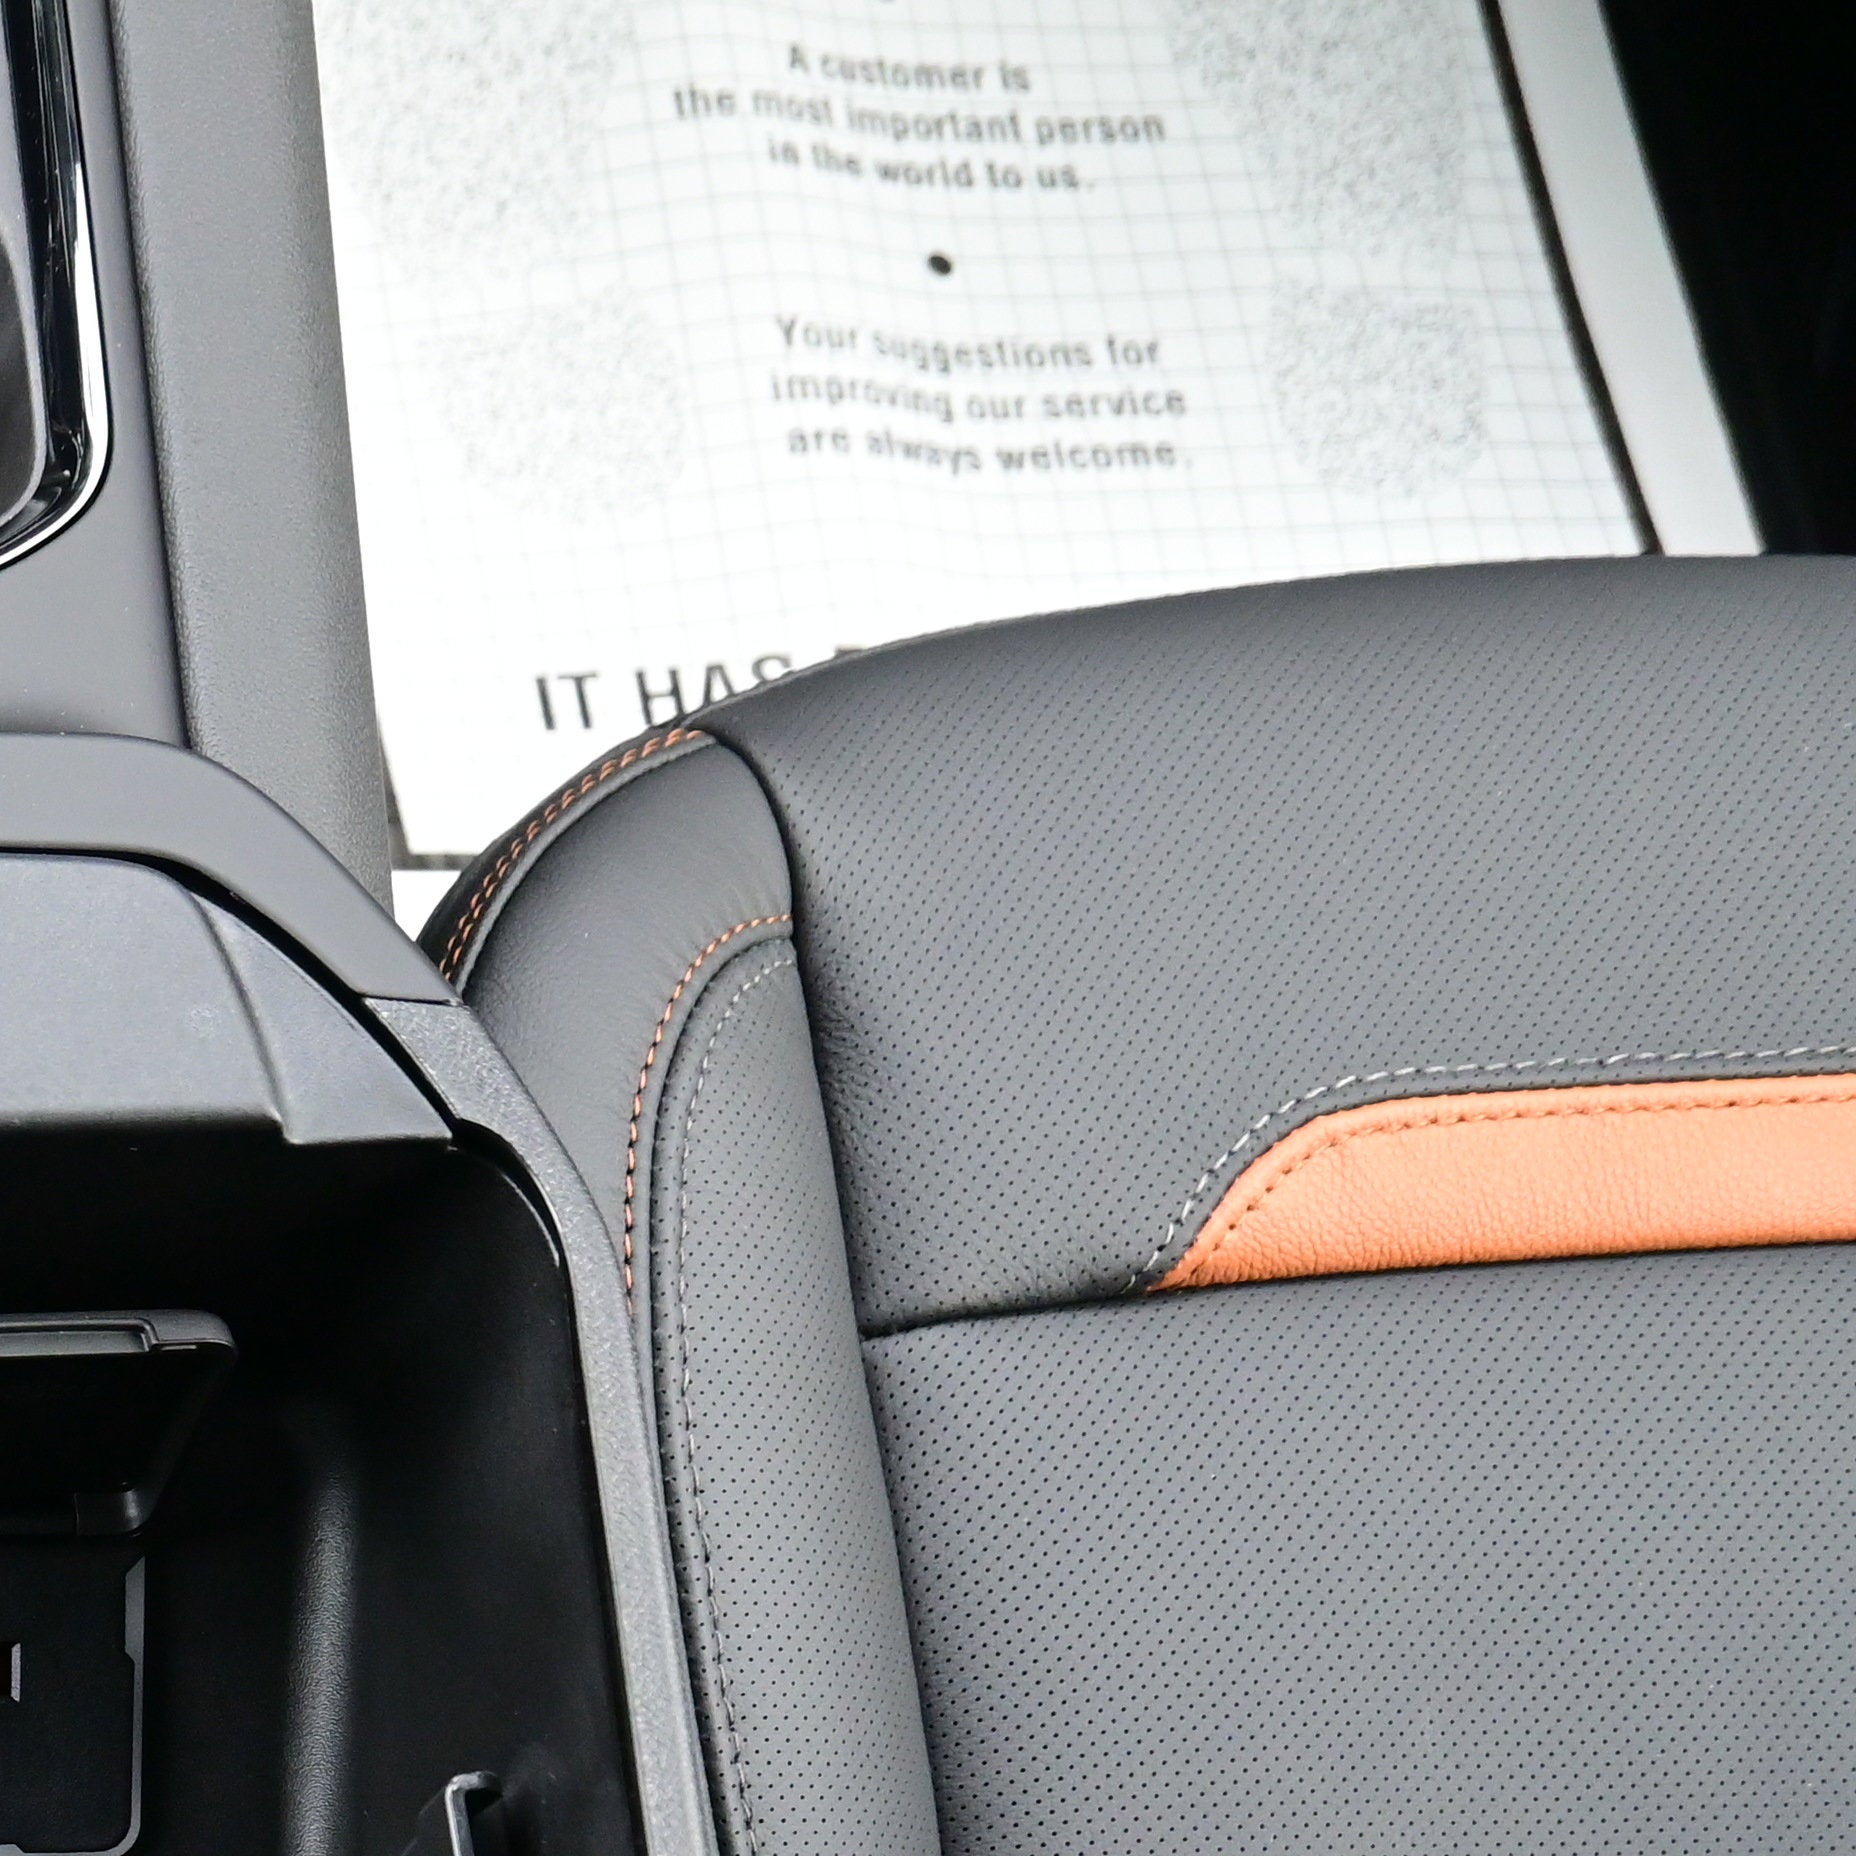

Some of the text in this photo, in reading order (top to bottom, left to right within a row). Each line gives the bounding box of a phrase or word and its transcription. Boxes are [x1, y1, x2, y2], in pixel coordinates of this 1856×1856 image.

[789, 42, 1031, 93] A customer is
[673, 85, 1166, 146] the most important person
[767, 133, 1095, 191] in the world to us.
[774, 315, 1161, 374] Your suggestions for
[771, 370, 1186, 424] improving our service
[788, 428, 850, 455] are
[866, 427, 982, 476] always
[536, 670, 598, 731] IT
